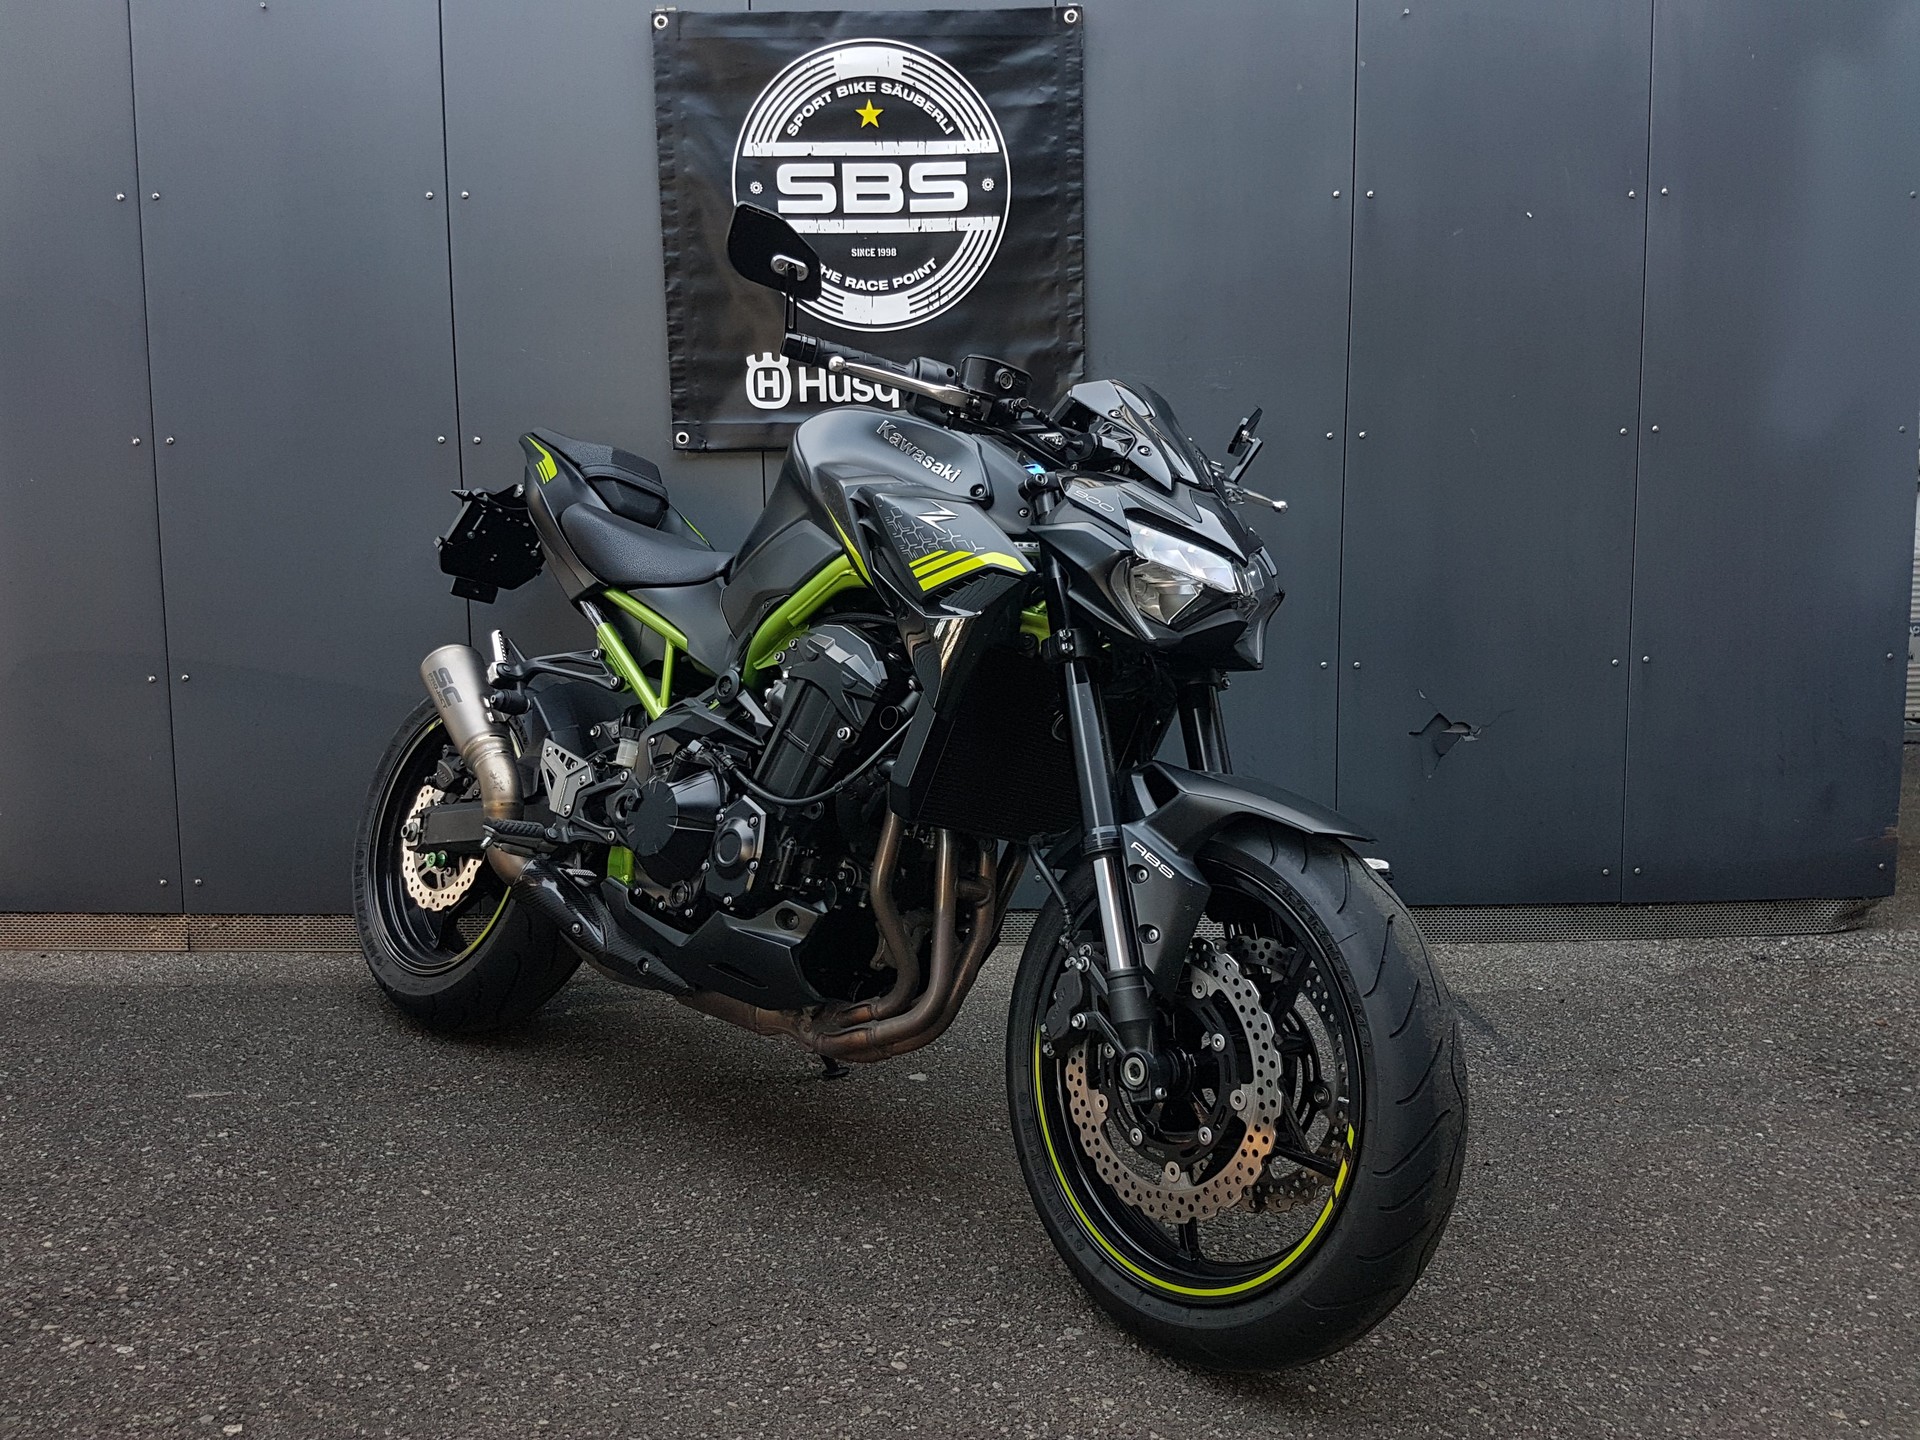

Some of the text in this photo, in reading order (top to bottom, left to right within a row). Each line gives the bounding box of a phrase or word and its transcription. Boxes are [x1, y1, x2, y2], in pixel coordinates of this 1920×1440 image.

[786, 81, 955, 137] SPORT BIKE SÄUBERLI
[776, 161, 969, 214] SBS
[851, 248, 897, 257] SINCE 1998
[844, 276, 889, 291] RACE
[892, 257, 937, 289] POINT
[876, 419, 962, 483] Kawasaki
[1073, 490, 1115, 512] 900
[427, 672, 447, 709] PROJECT
[432, 667, 463, 707] SC
[1130, 841, 1175, 879] ABS
